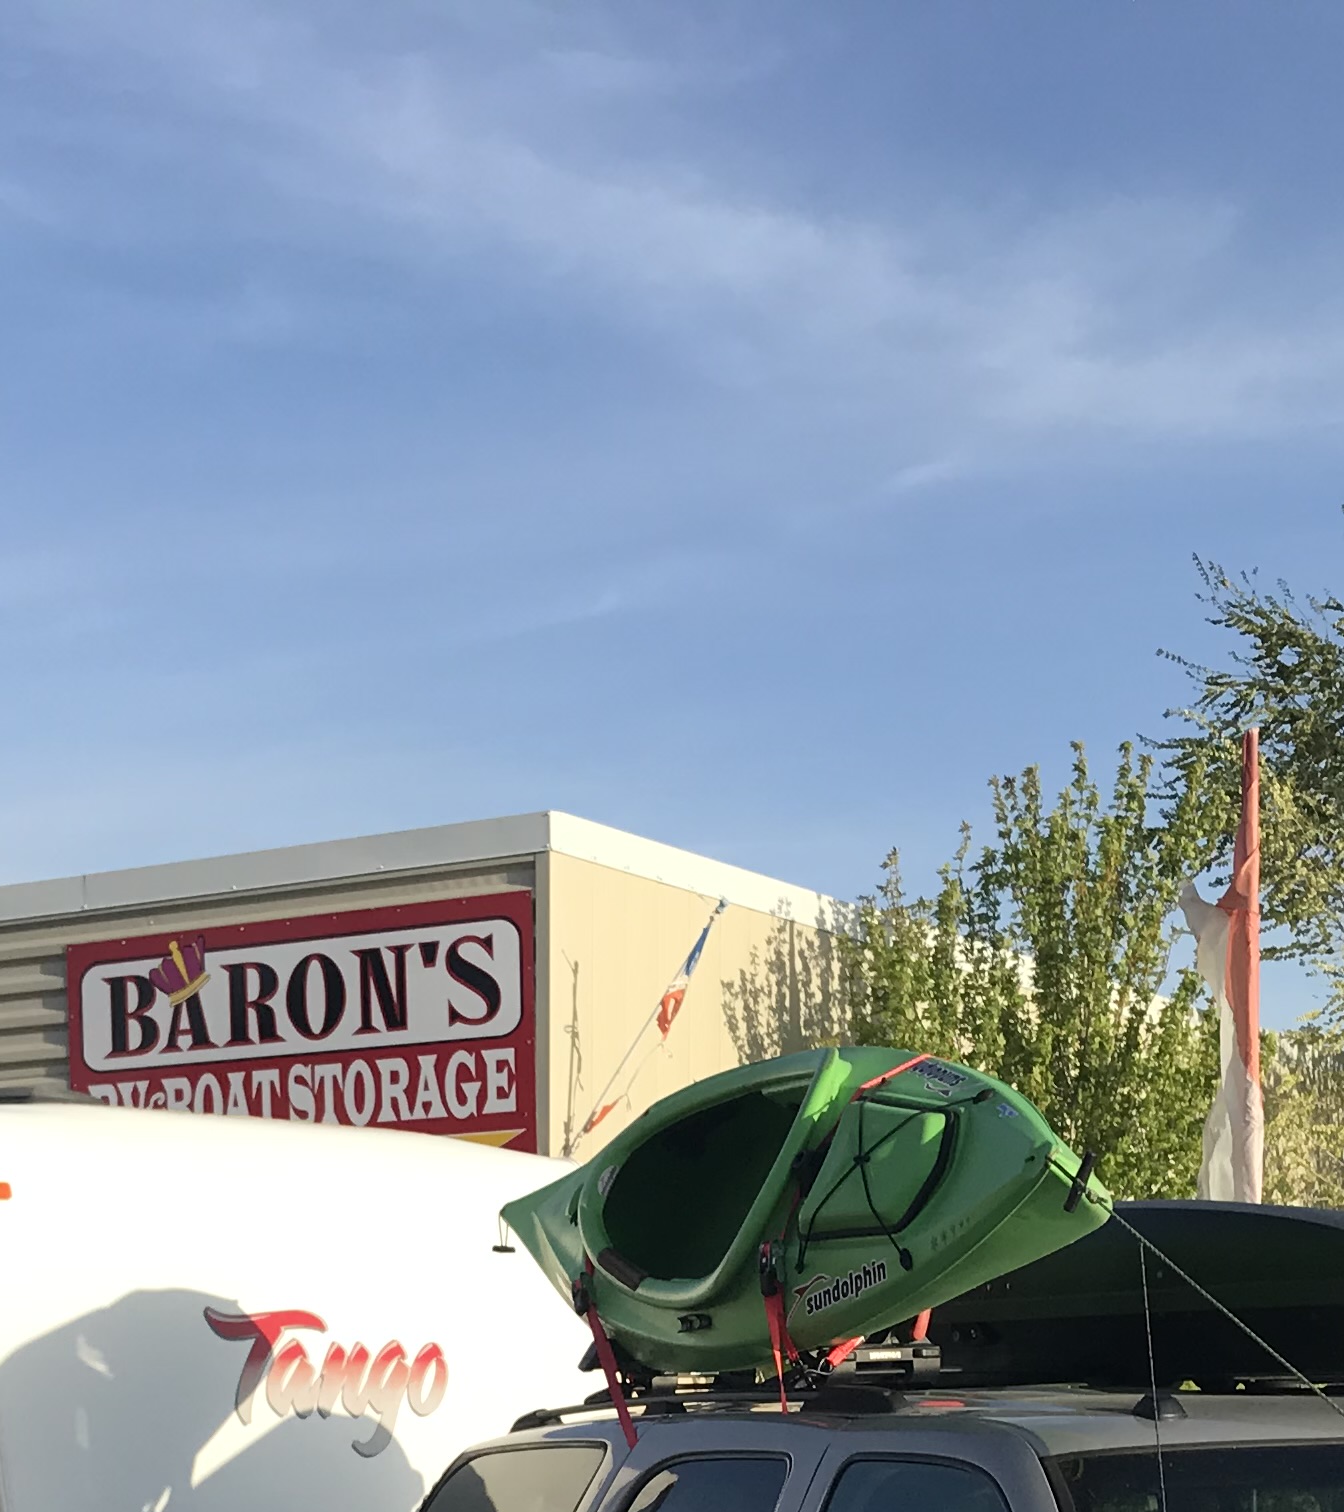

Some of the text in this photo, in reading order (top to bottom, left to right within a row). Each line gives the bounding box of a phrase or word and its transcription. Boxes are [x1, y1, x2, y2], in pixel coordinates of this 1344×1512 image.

[103, 934, 502, 1059] BARON'S
[287, 1047, 517, 1126] STORAGE
[806, 1259, 888, 1316] sundolphin
[201, 1306, 448, 1458] Tango
